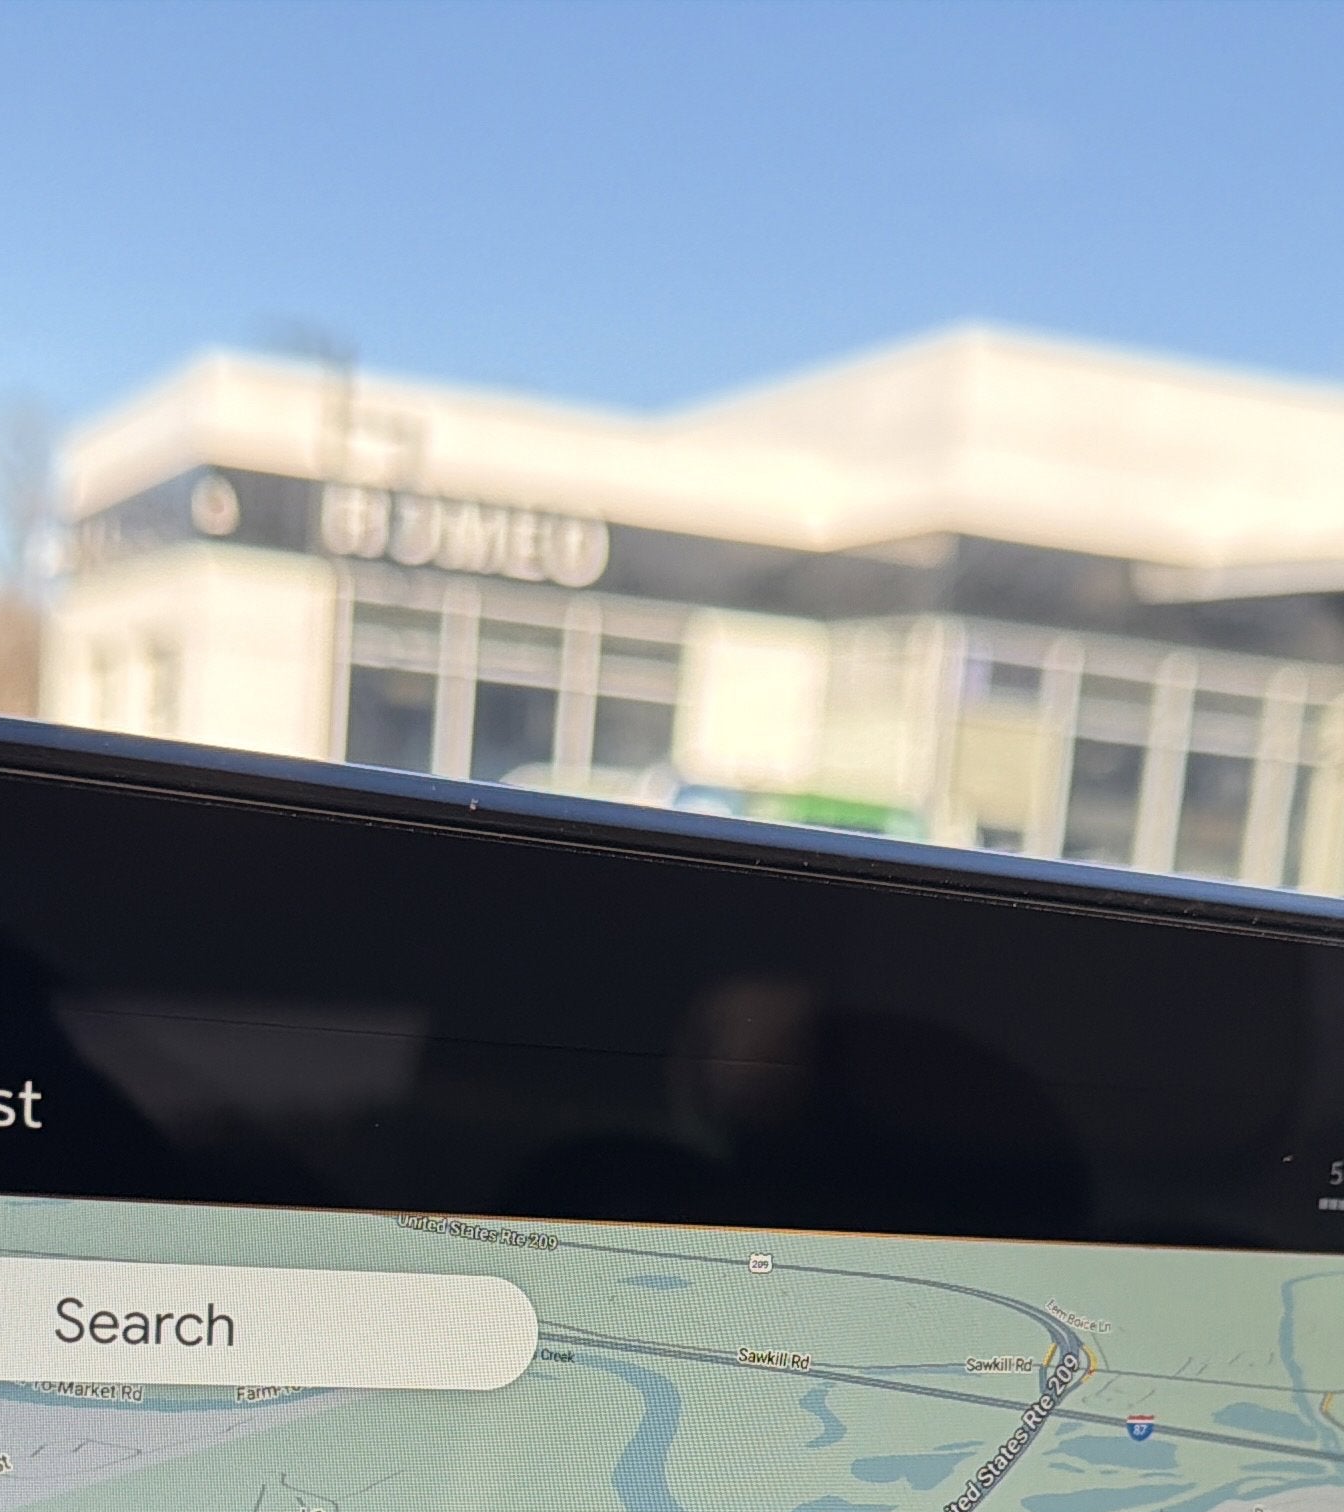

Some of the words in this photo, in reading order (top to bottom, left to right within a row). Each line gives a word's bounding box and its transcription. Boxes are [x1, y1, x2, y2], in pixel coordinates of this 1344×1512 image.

[449, 1221, 497, 1243] States
[527, 1232, 559, 1250] 209
[751, 1258, 769, 1270] 209
[55, 1297, 235, 1347] Search
[738, 1347, 789, 1368] Sawkill
[791, 1354, 811, 1370] Rd
[966, 1358, 1012, 1372] Sawkill
[1014, 1358, 1032, 1372] Rd
[121, 1385, 143, 1401] Rd
[975, 1426, 1027, 1489] States
[1022, 1391, 1054, 1429] Rte
[1048, 1352, 1080, 1396] 209
[1133, 1423, 1149, 1436] 87
